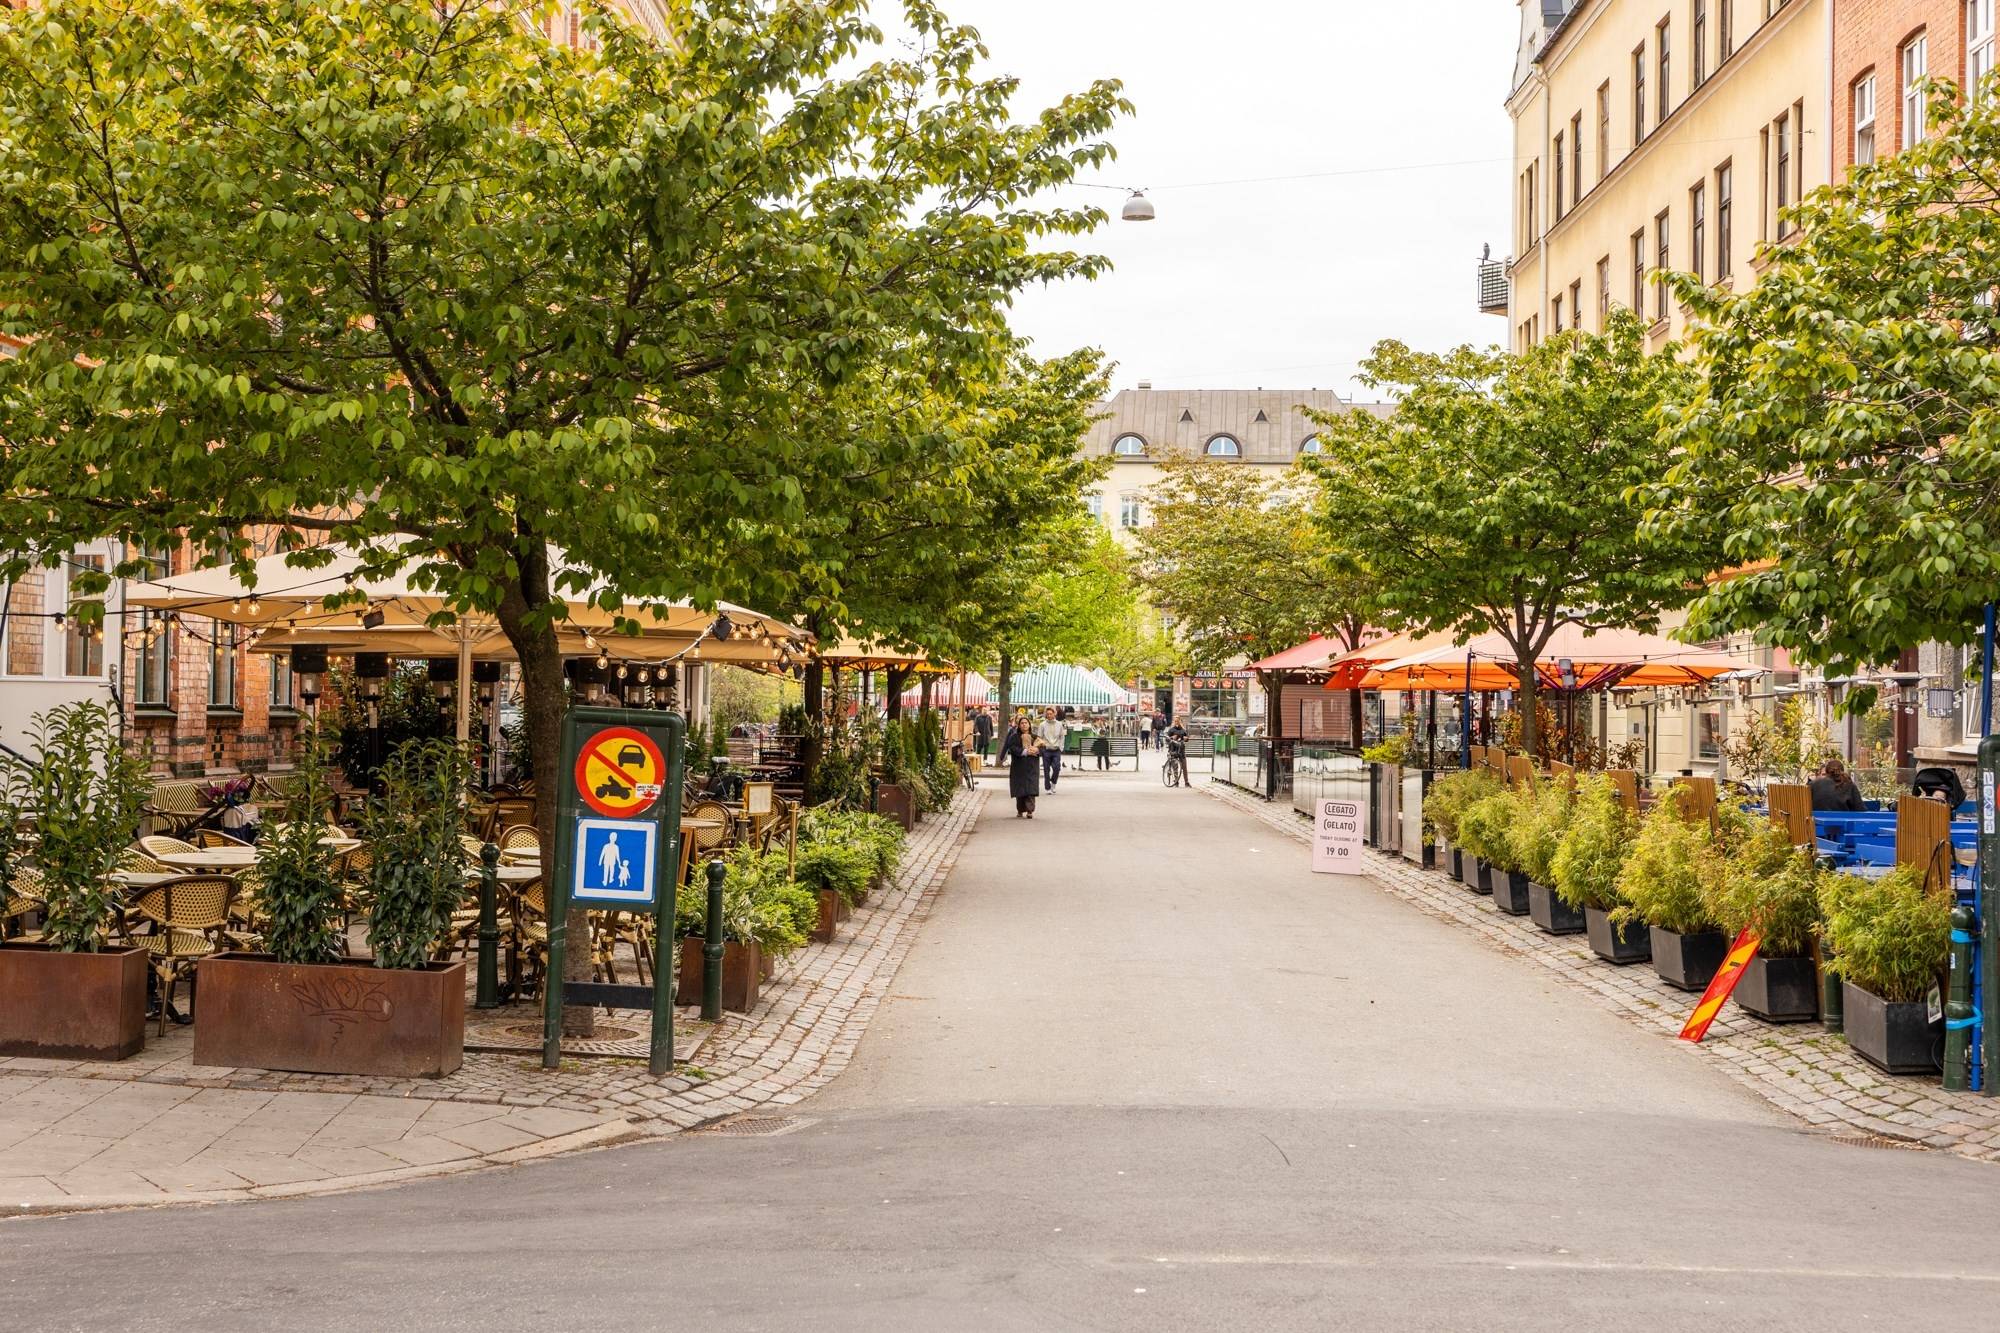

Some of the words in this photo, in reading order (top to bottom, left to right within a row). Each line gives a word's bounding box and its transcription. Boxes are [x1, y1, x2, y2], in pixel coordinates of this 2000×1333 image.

[1327, 805, 1354, 815] LEGATO
[1326, 847, 1335, 856] 19
[1338, 848, 1349, 857] 00
